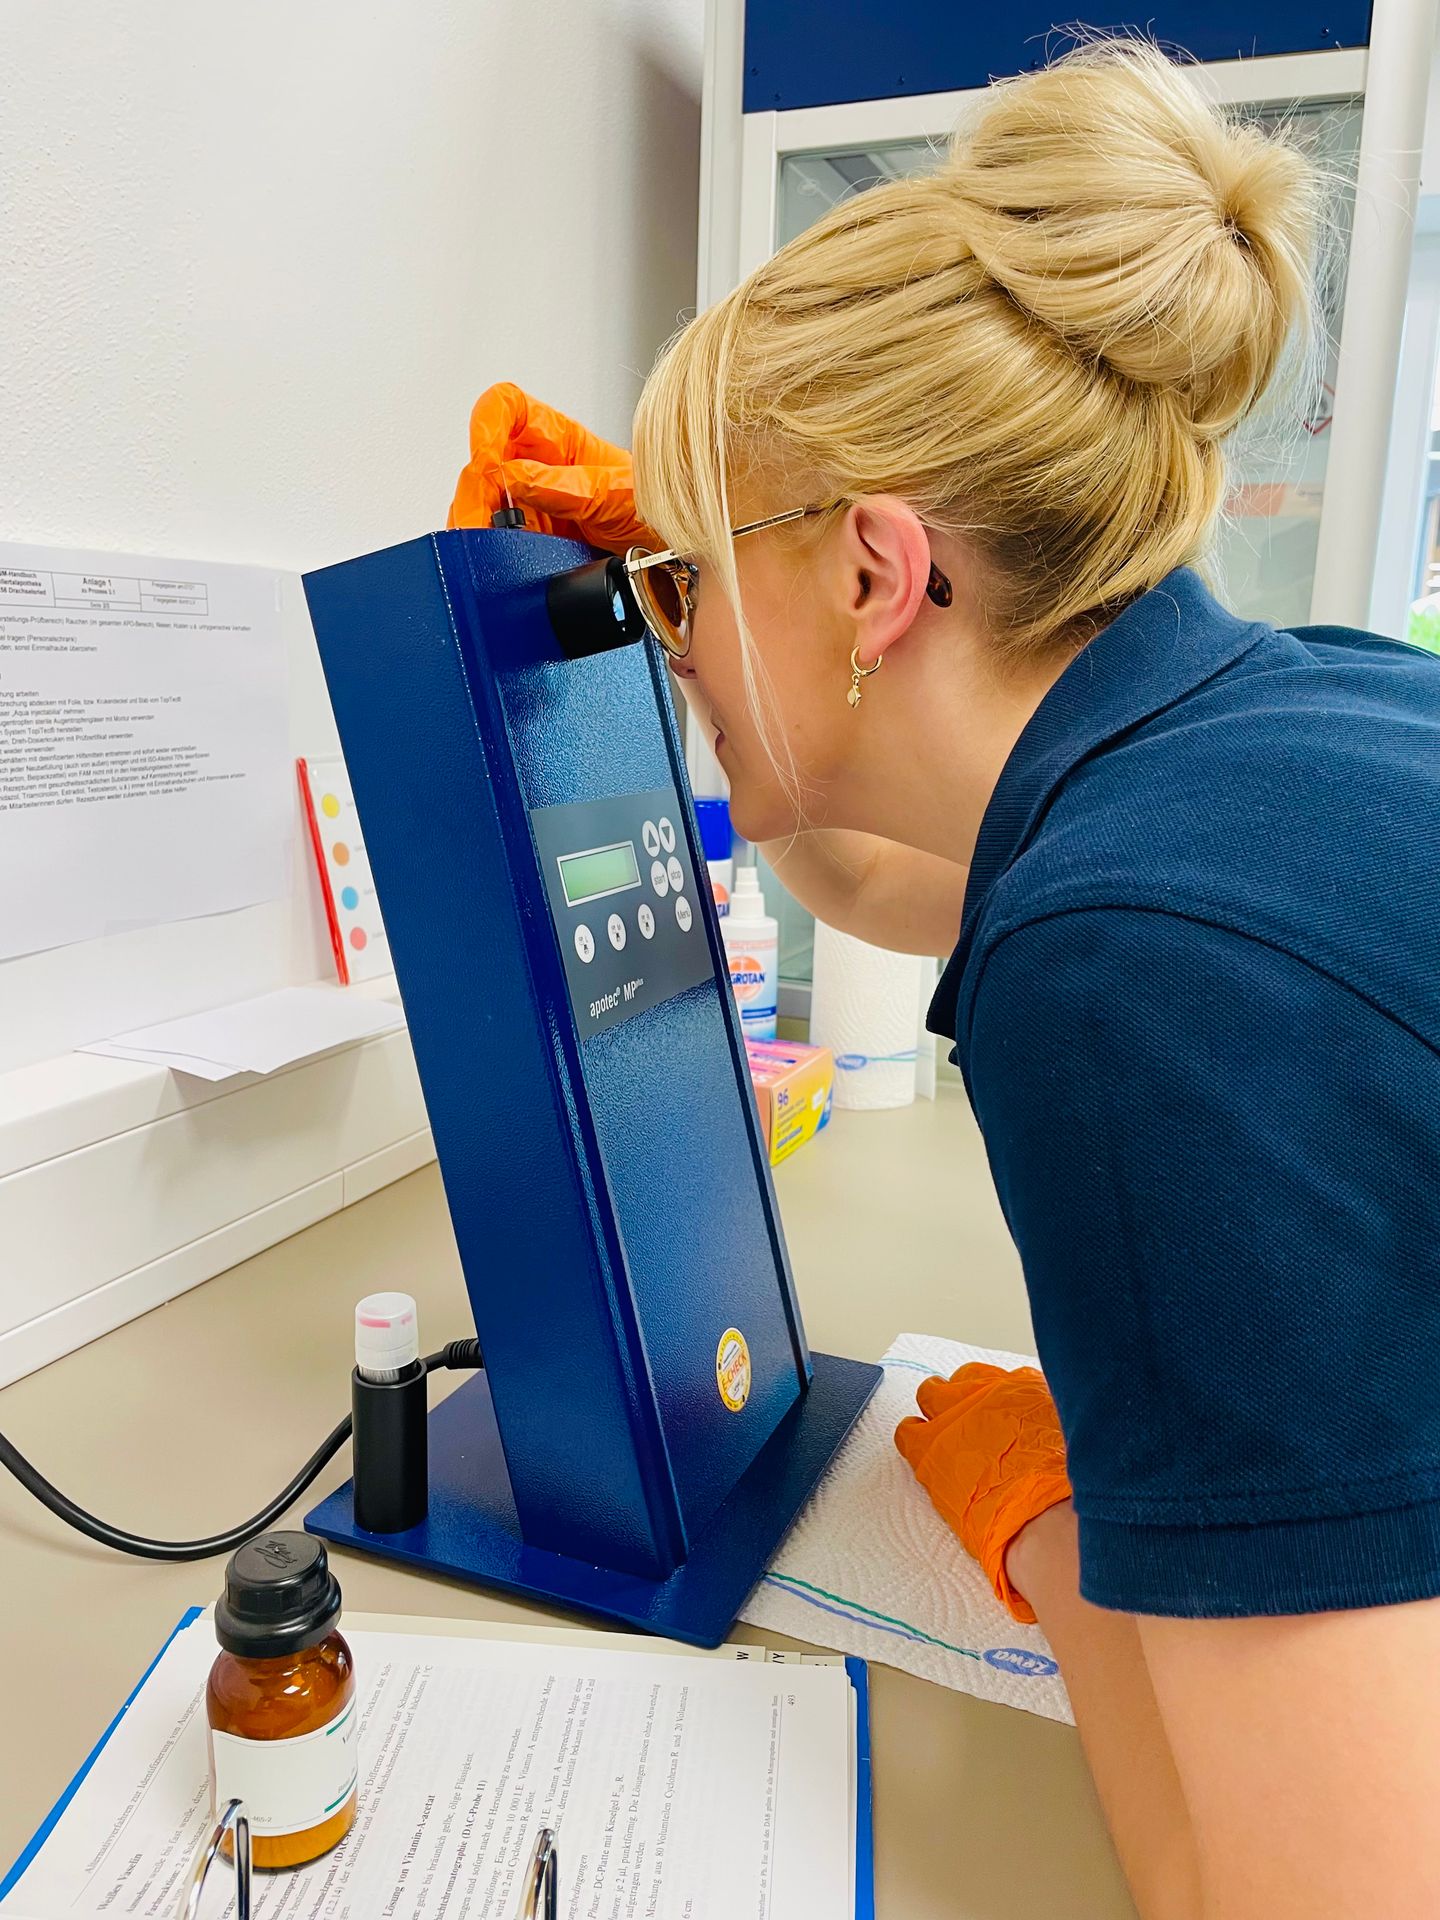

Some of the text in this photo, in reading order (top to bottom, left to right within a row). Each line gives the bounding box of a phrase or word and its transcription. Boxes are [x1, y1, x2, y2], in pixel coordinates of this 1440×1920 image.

[82, 577, 112, 588] Anlage 1
[777, 1088, 789, 1111] 96
[362, 1690, 381, 1718] Trocknen
[376, 1679, 386, 1688] der
[381, 1663, 391, 1677] Sub-
[408, 1681, 427, 1710] höchstens
[542, 1675, 556, 1695] Menge
[581, 1702, 590, 1714] wird
[646, 1684, 661, 1720] Anwendung
[676, 1687, 688, 1721] Volumteilen
[403, 1712, 414, 1726] darf
[532, 1697, 548, 1742] entsprechende
[643, 1721, 652, 1737] ohne
[674, 1723, 683, 1732] 20
[506, 1728, 521, 1762] verwenden.
[544, 1775, 559, 1802] Vitamin
[557, 1718, 573, 1763] entsprechende
[568, 1695, 580, 1715] Menge
[570, 1730, 583, 1755] bekannt
[640, 1739, 649, 1763] müssen
[673, 1735, 681, 1747] und
[358, 1789, 371, 1801] Die
[365, 1755, 385, 1786] Differenz
[381, 1724, 397, 1752] zwischen
[392, 1711, 402, 1721] der
[375, 1729, 408, 1794] Mischschmelzpunkt
[518, 1754, 533, 1779] Vitamin
[454, 1753, 474, 1790] Flüssigkeit.
[502, 1764, 511, 1774] zu
[562, 1758, 576, 1787] Identität
[632, 1765, 646, 1797] Lösungen
[664, 1759, 678, 1798] Cyclohexan
[85, 1805, 134, 1873] Alternativverfahren
[131, 1791, 141, 1802] zur
[137, 1740, 174, 1788] Identifizierung
[170, 1727, 181, 1738] von
[368, 1798, 380, 1813] dem
[448, 1792, 461, 1809] ölige
[488, 1775, 509, 1815] Herstellung
[509, 1798, 520, 1811] 000
[525, 1791, 536, 1813] gelöst.
[557, 1790, 569, 1809] deren
[629, 1800, 639, 1812] Die
[462, 1794, 482, 1838] (DAC-Probe
[477, 1780, 488, 1790] 11)
[505, 1813, 516, 1822] 10
[605, 1800, 620, 1832] Kieselgel
[363, 1817, 373, 1830] und
[443, 1812, 456, 1833] gelbe,
[484, 1818, 495, 1830] der
[503, 1826, 512, 1843] etwa
[656, 1803, 671, 1845] Volumteilen
[345, 1834, 366, 1867] Substanz
[480, 1833, 491, 1850] nach
[508, 1824, 527, 1867] Cyclohexan
[603, 1836, 612, 1847] mit
[622, 1817, 638, 1864] punktförmig.
[654, 1847, 665, 1857] 80
[149, 1858, 166, 1878] weiße
[160, 1846, 173, 1856] bis
[169, 1831, 183, 1843] fast
[382, 1796, 435, 1917] Lösung von Vitamin-A-acetat
[427, 1836, 446, 1870] bräunlich
[472, 1853, 484, 1875] sofort
[494, 1847, 506, 1863] Eine
[145, 1871, 180, 1916] Farbreaktion:
[183, 1822, 209, 1854] Substanz
[339, 1871, 350, 1883] der
[422, 1874, 433, 1884] bis
[504, 1869, 516, 1881] ml
[593, 1850, 609, 1888] DC-Platte
[626, 1841, 646, 1918] aufgetragen werden.
[96, 1854, 142, 1910] Weißes Vaselin
[465, 1879, 476, 1894] sind
[498, 1889, 510, 1897] in
[613, 1884, 626, 1894] je
[325, 1887, 345, 1914] (2.2.14)
[417, 1888, 429, 1908] gelbe
[495, 1900, 506, 1917] wird
[587, 1892, 600, 1919] Phase:
[645, 1879, 662, 1917] Mischung
